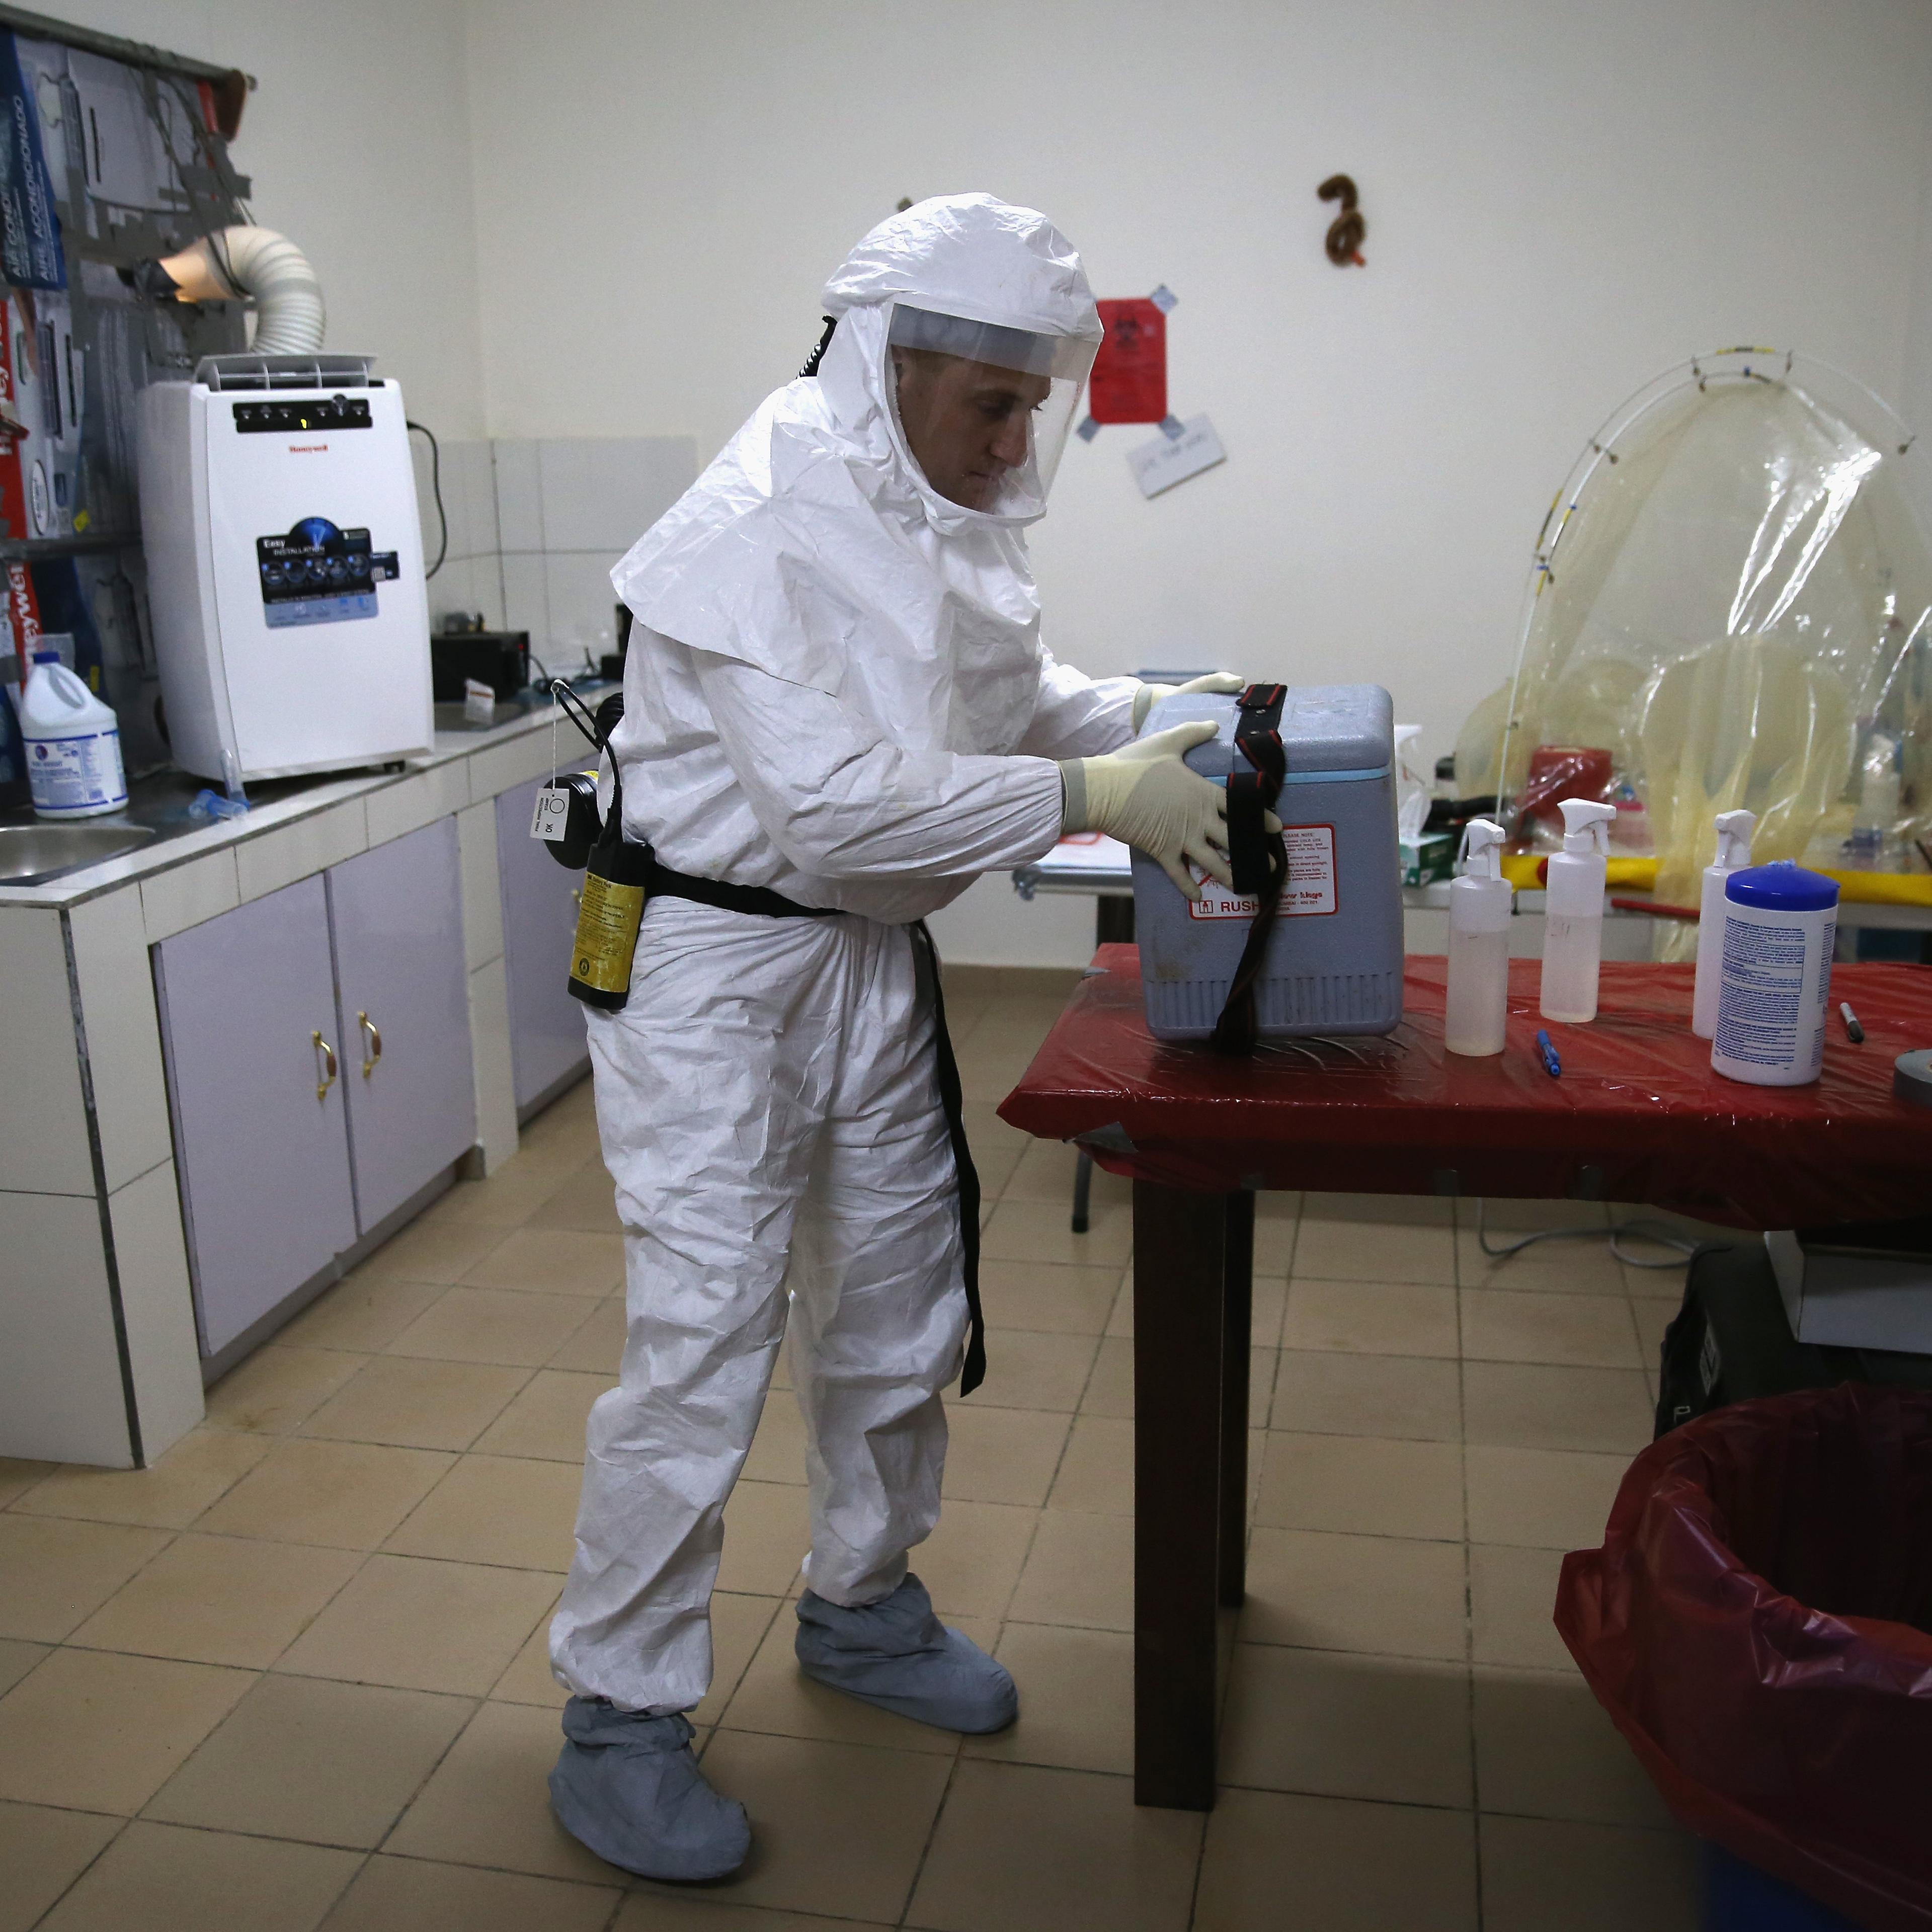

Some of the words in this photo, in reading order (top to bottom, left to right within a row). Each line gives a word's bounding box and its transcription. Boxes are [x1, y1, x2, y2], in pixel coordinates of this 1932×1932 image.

[13, 95, 43, 238] ACONDICIONADO
[289, 445, 329, 453] Honeywell
[264, 539, 285, 549] Easy
[545, 824, 553, 833] OK
